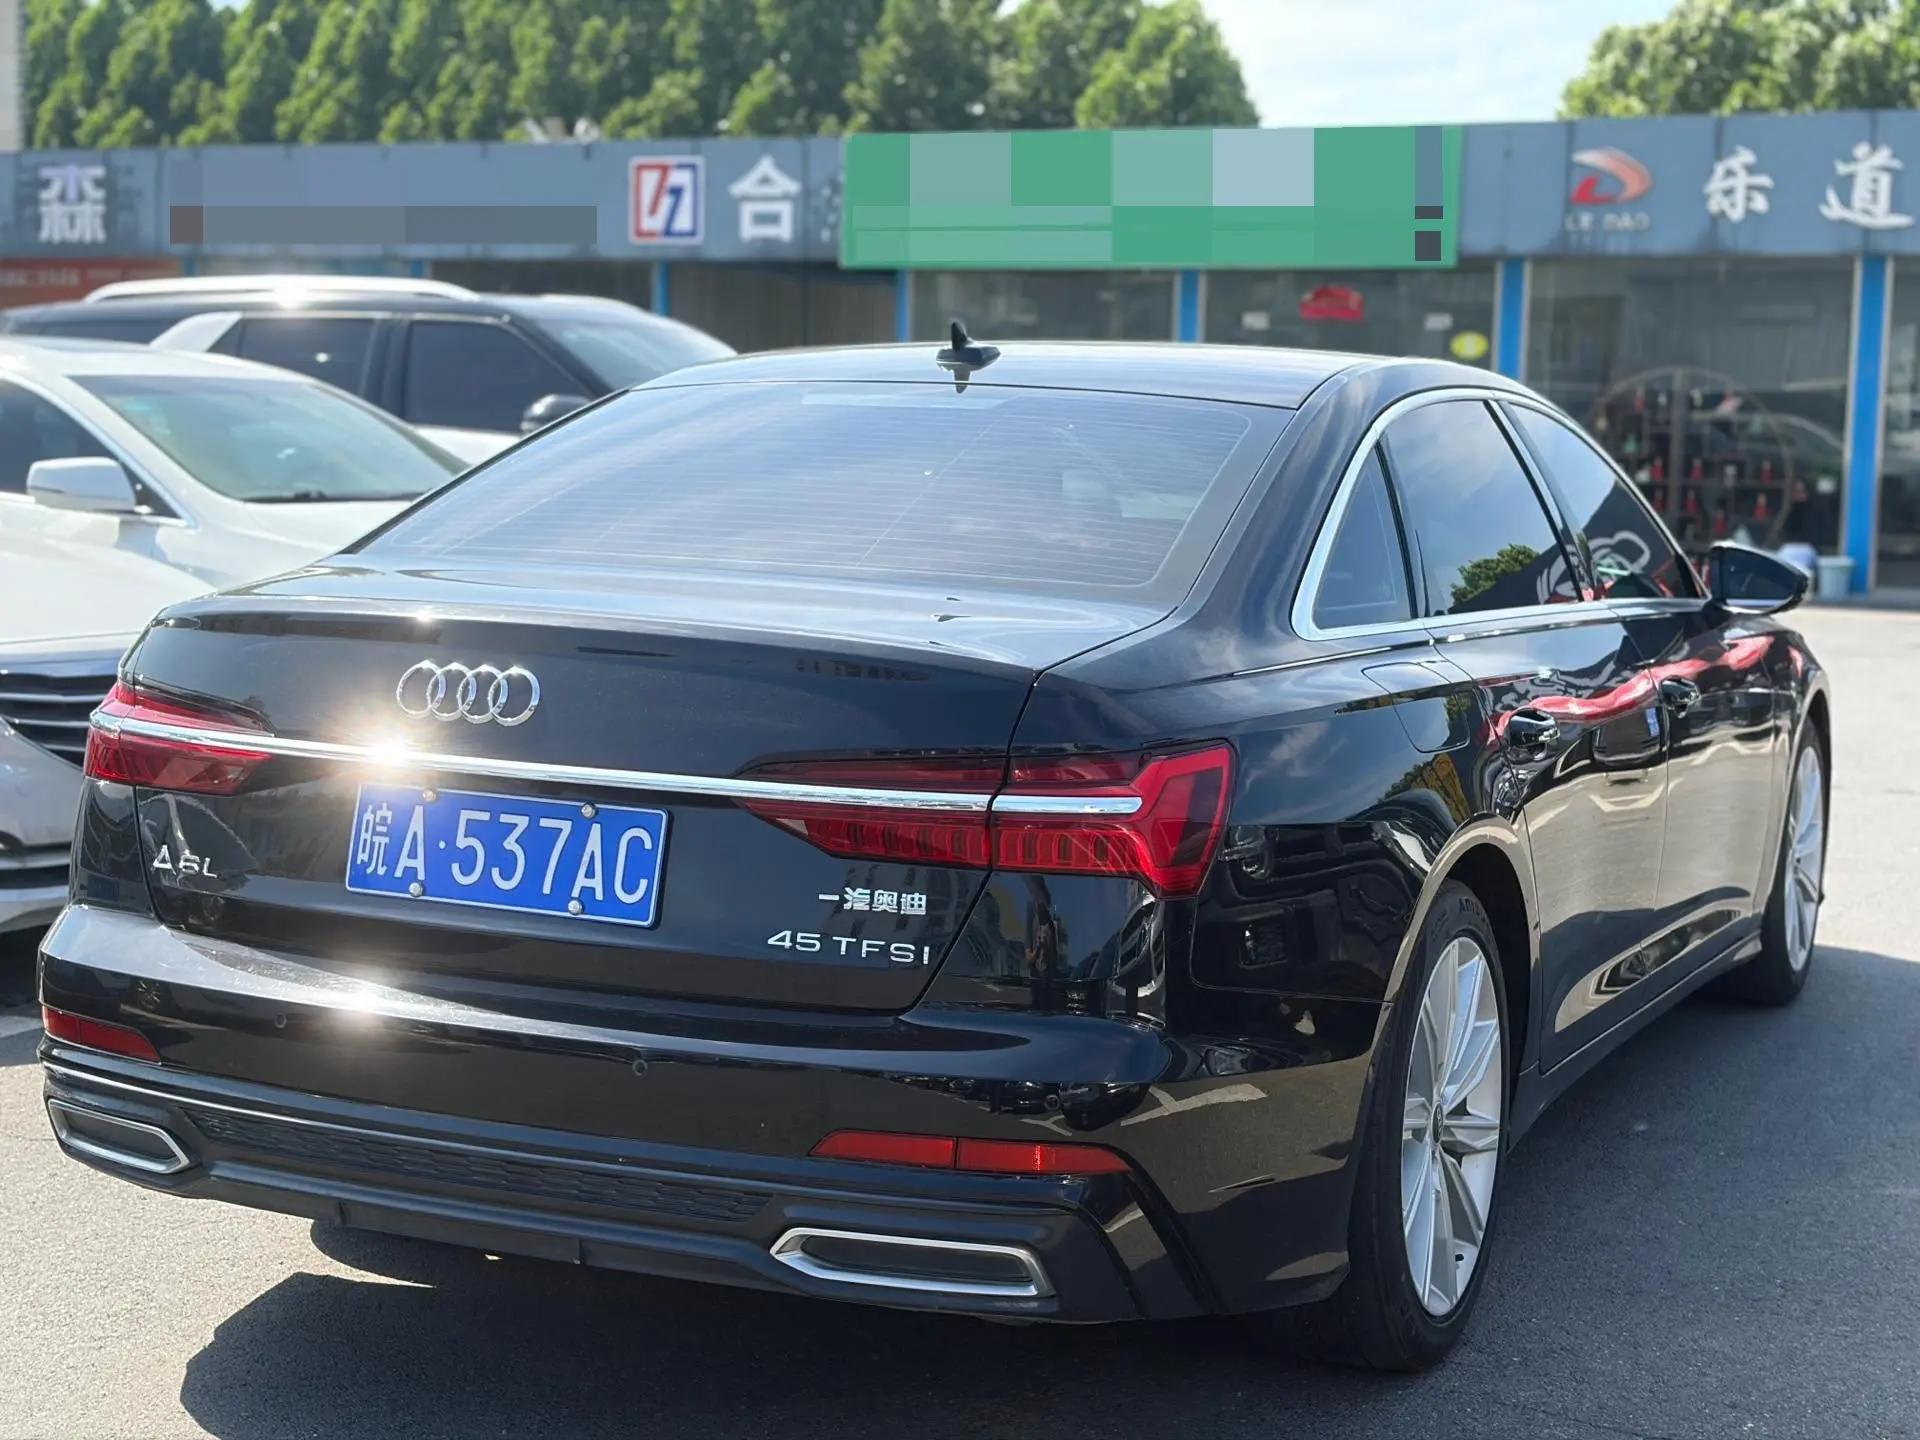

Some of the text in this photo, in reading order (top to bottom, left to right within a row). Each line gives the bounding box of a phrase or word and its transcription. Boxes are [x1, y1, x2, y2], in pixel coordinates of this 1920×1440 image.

[1703, 142, 1915, 229] 乐道
[38, 164, 106, 244] 森
[150, 844, 218, 878] A6L
[818, 887, 927, 916] 一汽奥迪
[767, 930, 930, 965] 45 TFSI
